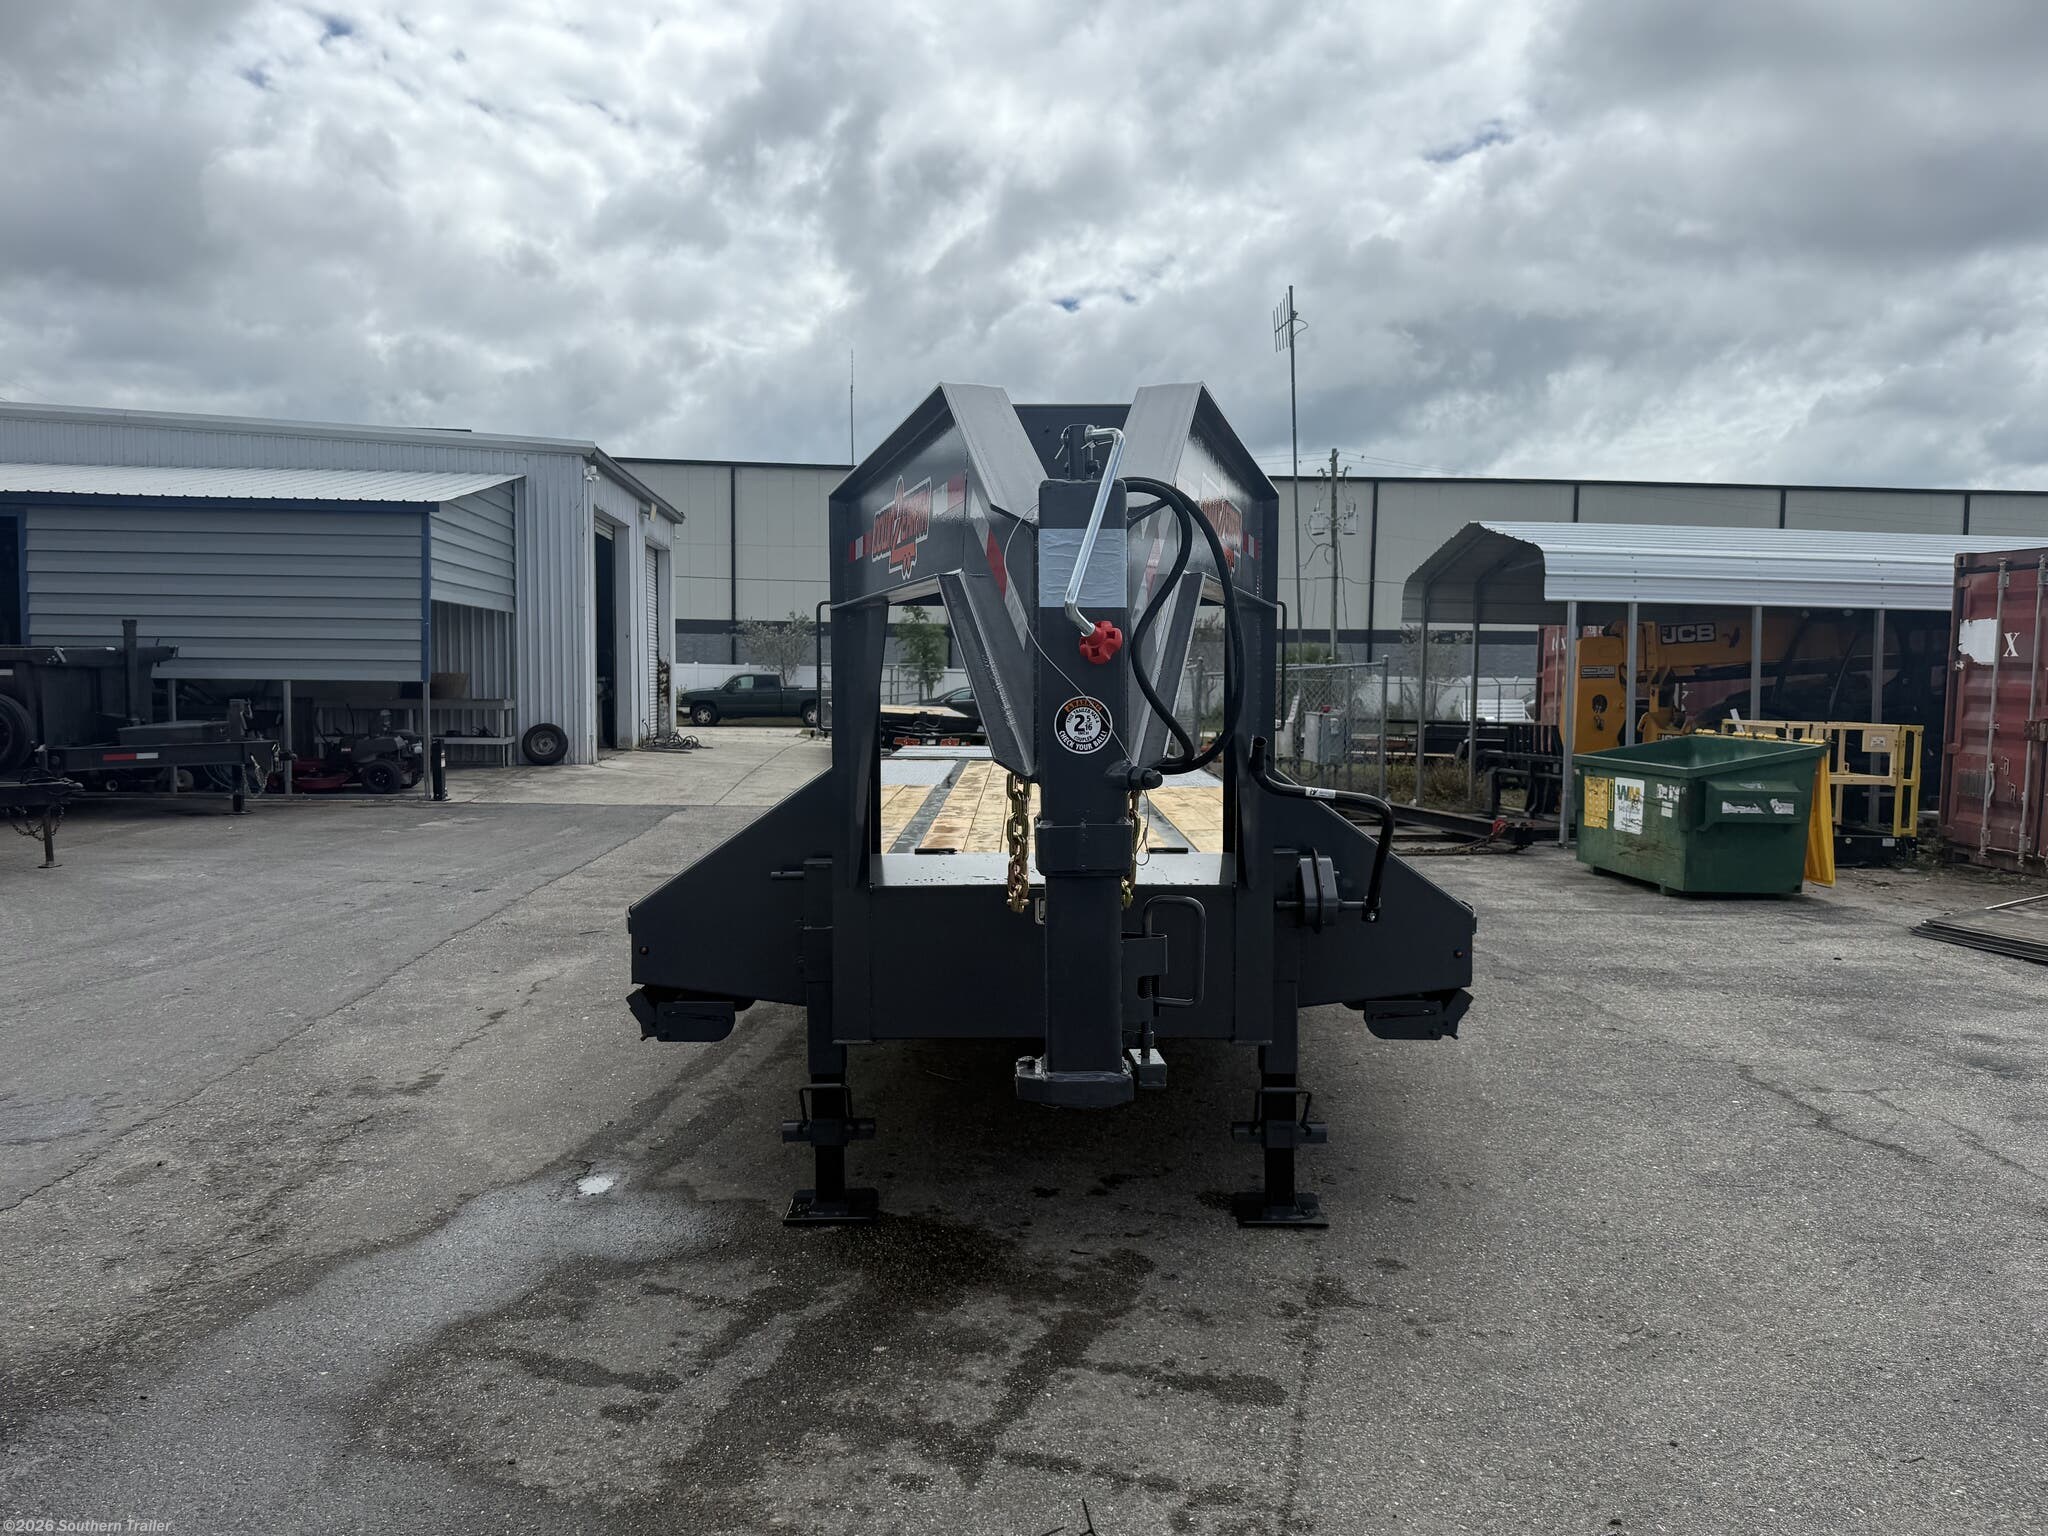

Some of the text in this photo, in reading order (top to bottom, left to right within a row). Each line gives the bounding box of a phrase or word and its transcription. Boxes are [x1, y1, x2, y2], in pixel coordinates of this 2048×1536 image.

[1662, 624, 1715, 643] JCB
[2003, 632, 2020, 657] X
[1074, 714, 1086, 732] 2
[1059, 730, 1074, 748] CHECK
